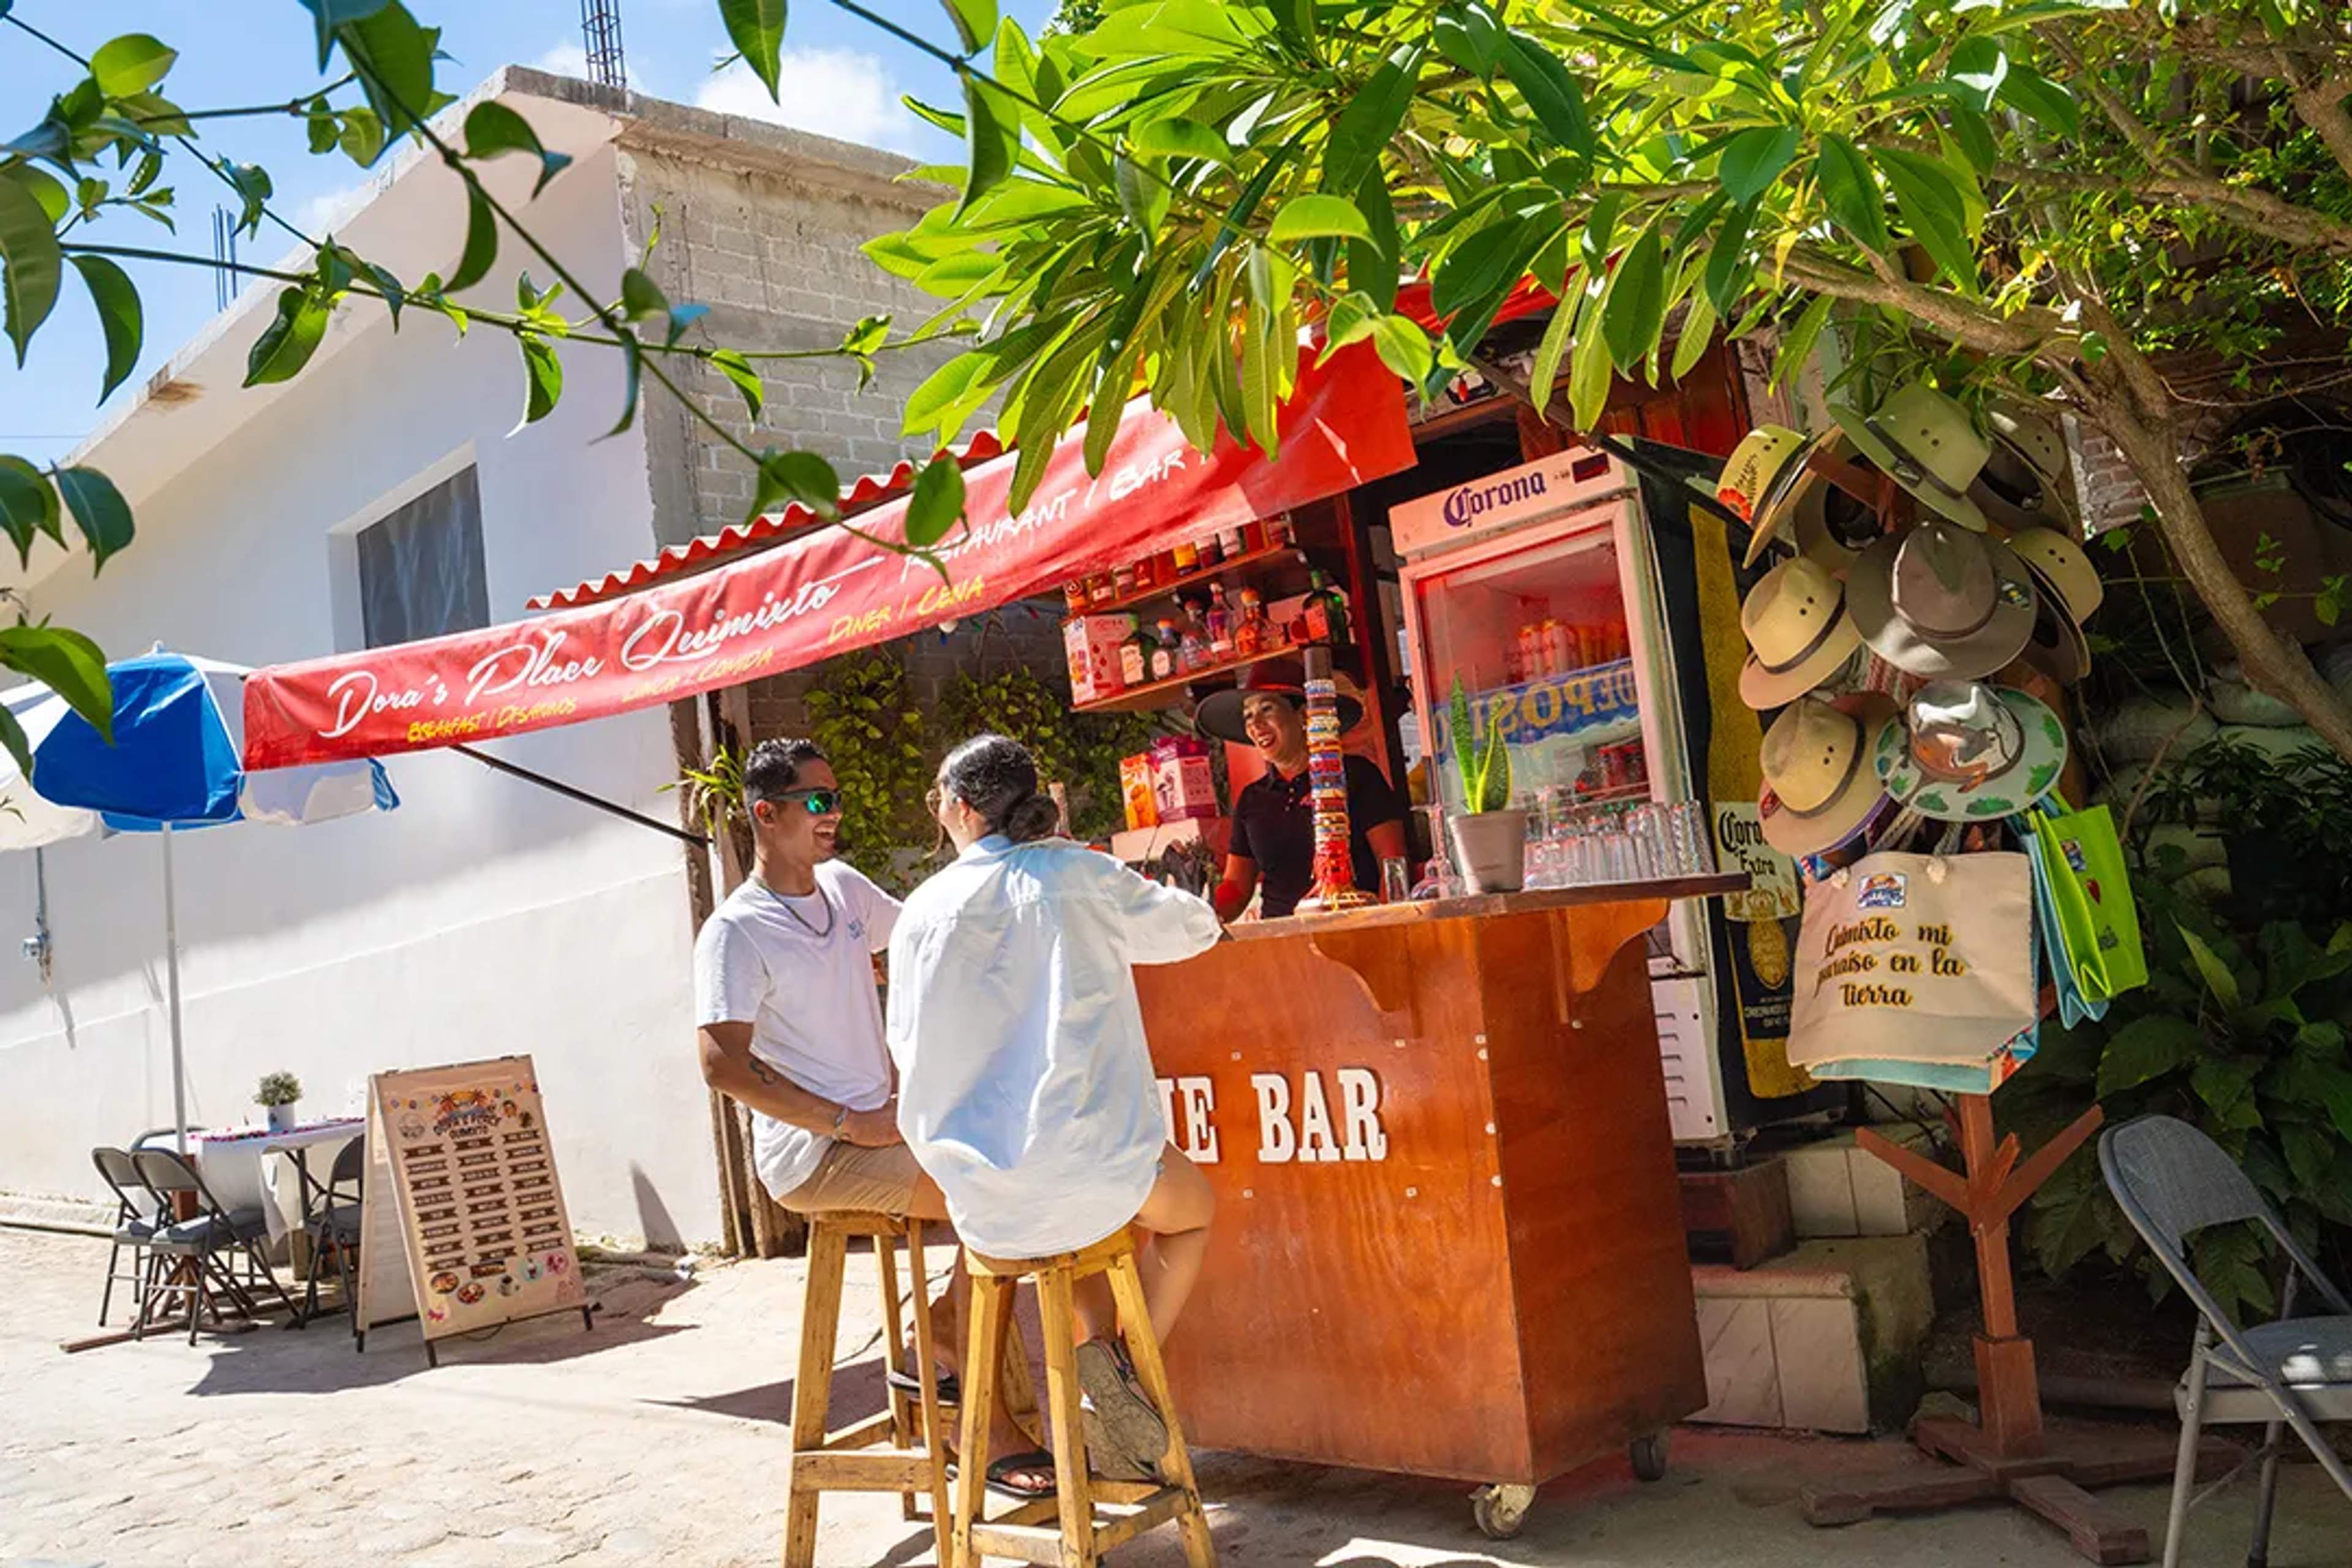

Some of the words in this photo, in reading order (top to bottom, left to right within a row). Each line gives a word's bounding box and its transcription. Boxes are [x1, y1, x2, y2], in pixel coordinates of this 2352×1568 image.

[1109, 448, 1186, 501] BAR
[1443, 472, 1547, 527] Corona
[917, 574, 986, 616] CENA
[464, 631, 605, 706] Place
[621, 556, 885, 671] Quimixto
[1718, 810, 1769, 853] Coro
[1917, 924, 1953, 946] mi
[1890, 953, 1921, 973] en
[1931, 947, 1965, 976] la
[1250, 1068, 1387, 1163] BAR
